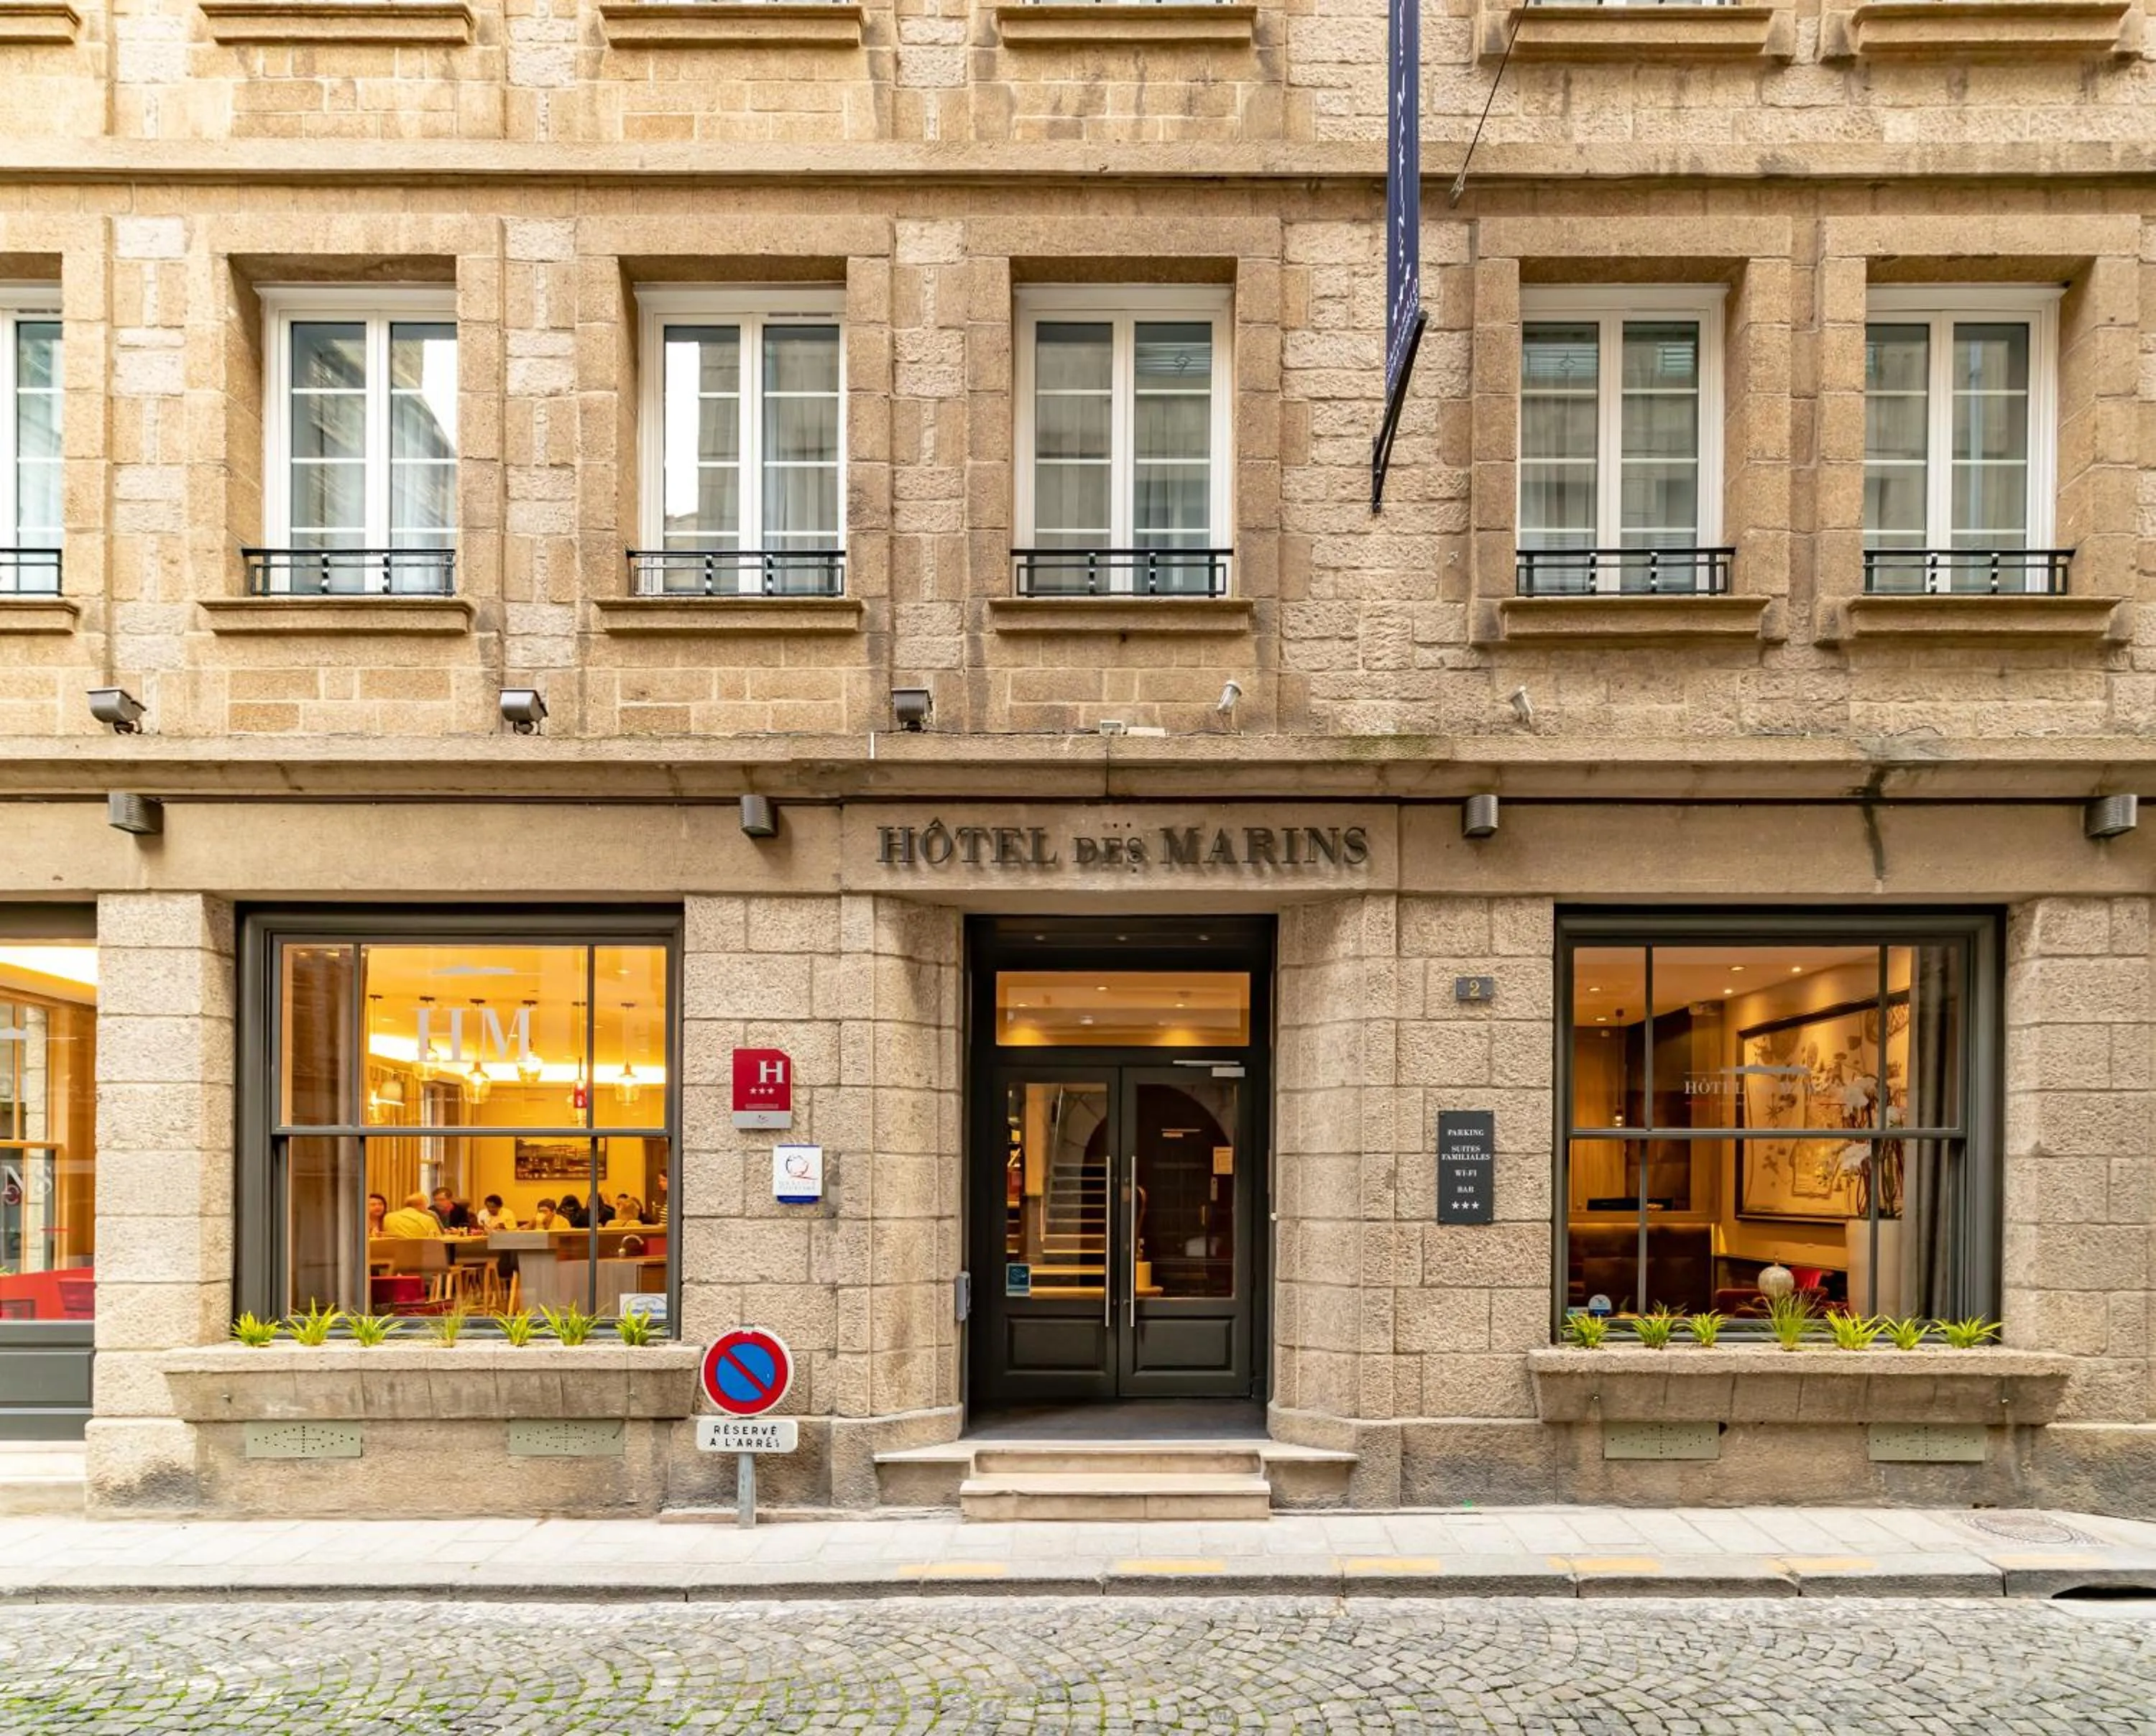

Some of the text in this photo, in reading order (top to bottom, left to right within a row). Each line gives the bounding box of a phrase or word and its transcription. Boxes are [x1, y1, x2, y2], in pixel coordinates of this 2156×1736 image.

[875, 816, 1368, 864] HÔTEL DES MARINS
[1469, 980, 1480, 997] 2
[410, 1007, 537, 1062] HM
[759, 1061, 785, 1084] H
